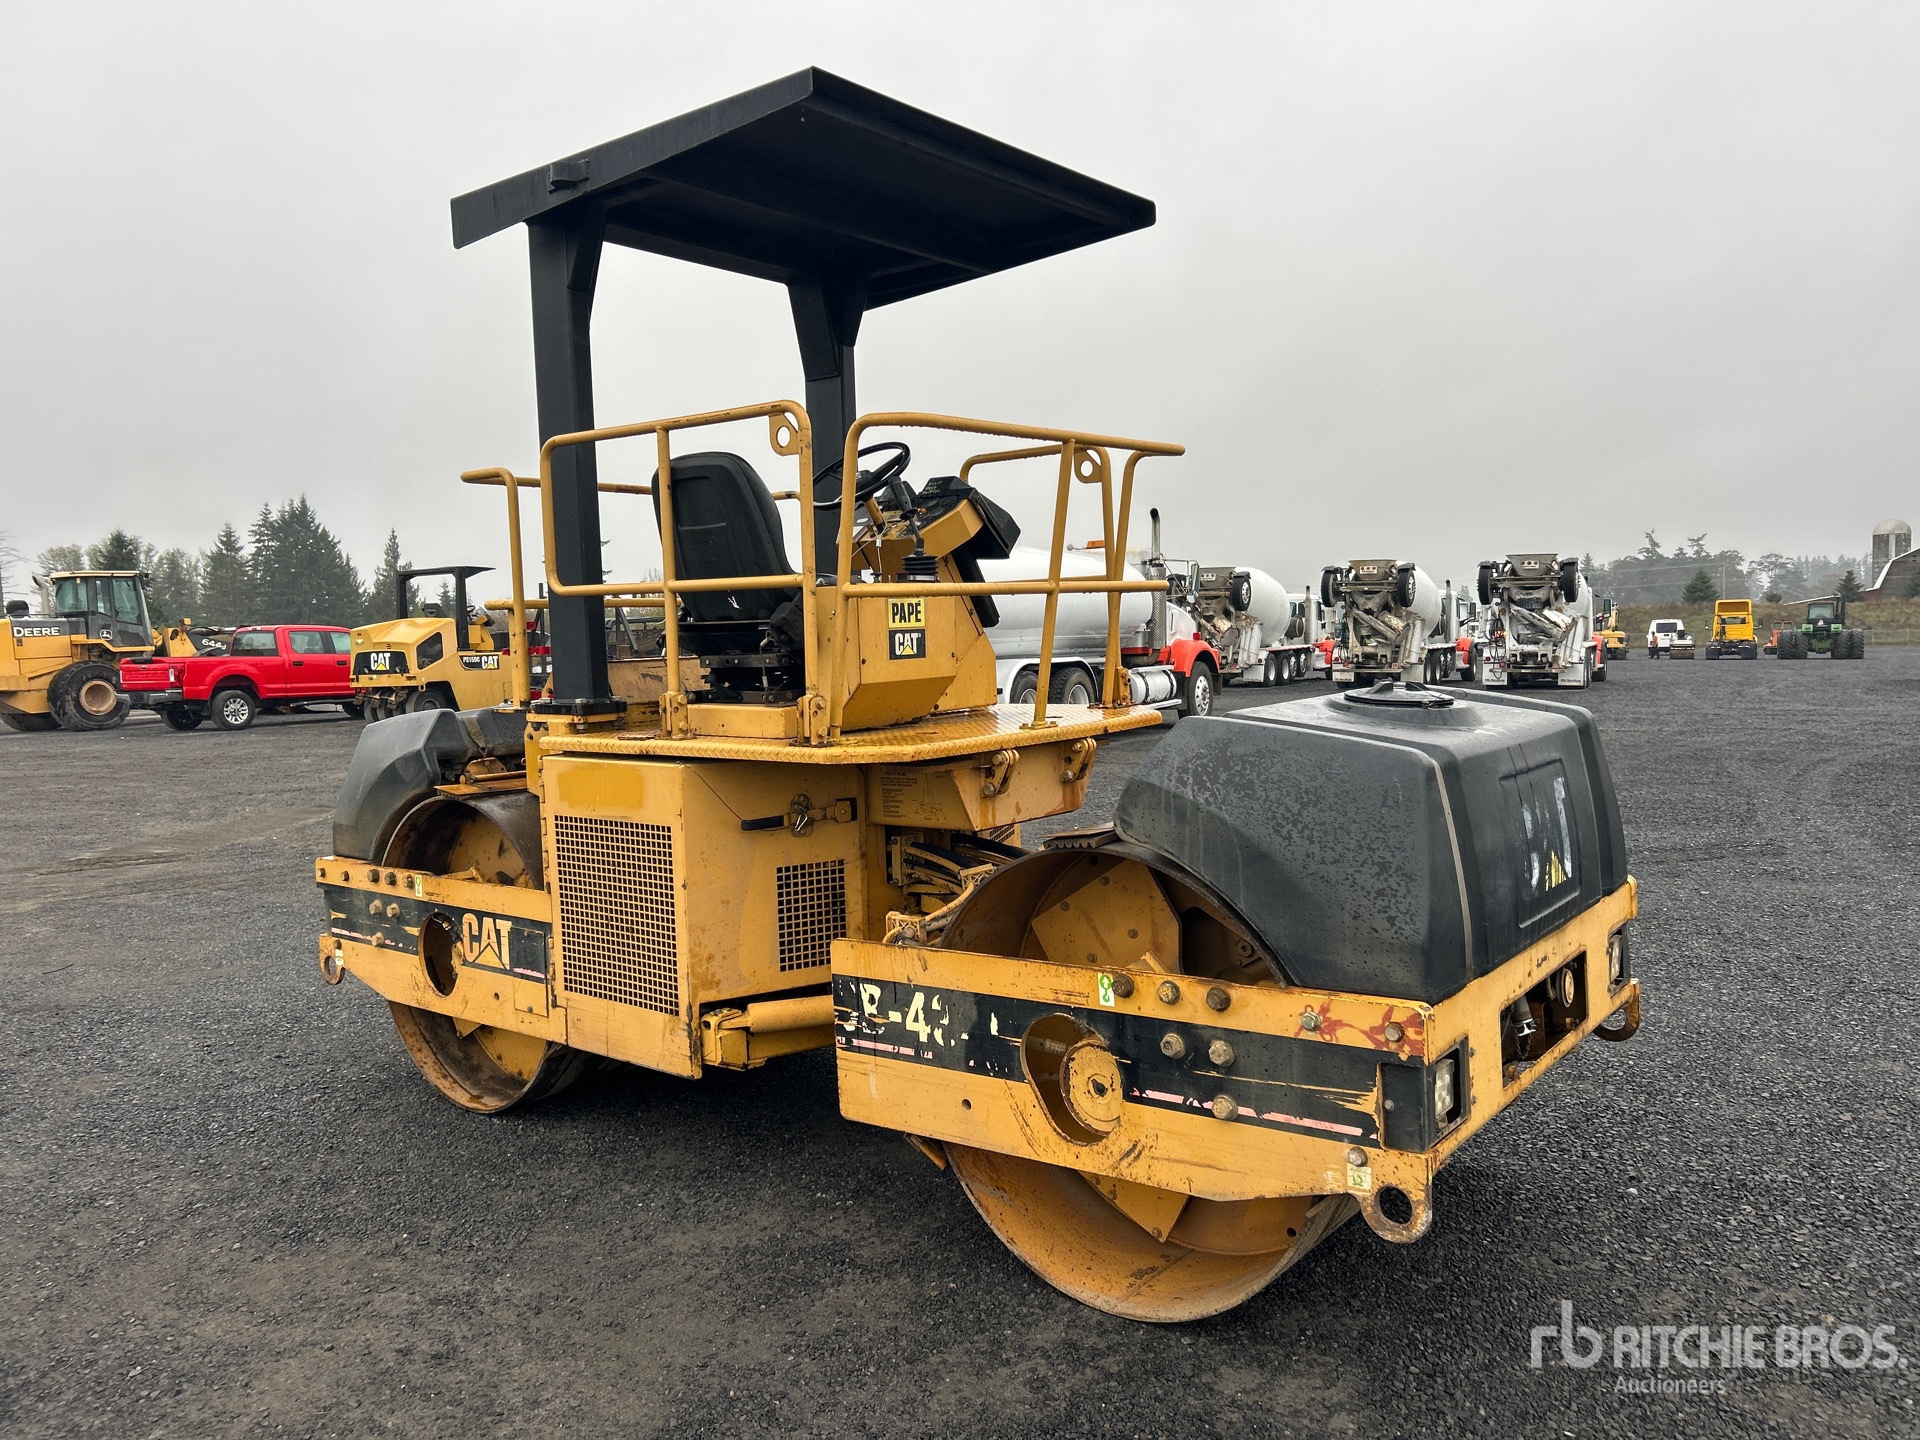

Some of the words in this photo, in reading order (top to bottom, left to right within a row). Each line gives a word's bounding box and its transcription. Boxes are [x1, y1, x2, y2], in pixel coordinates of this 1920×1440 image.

[891, 600, 922, 624] PAPÉ
[13, 626, 60, 638] DEERE
[894, 632, 922, 656] CAT
[370, 652, 391, 671] CAT
[481, 655, 499, 670] CAT
[462, 912, 512, 970] CAT
